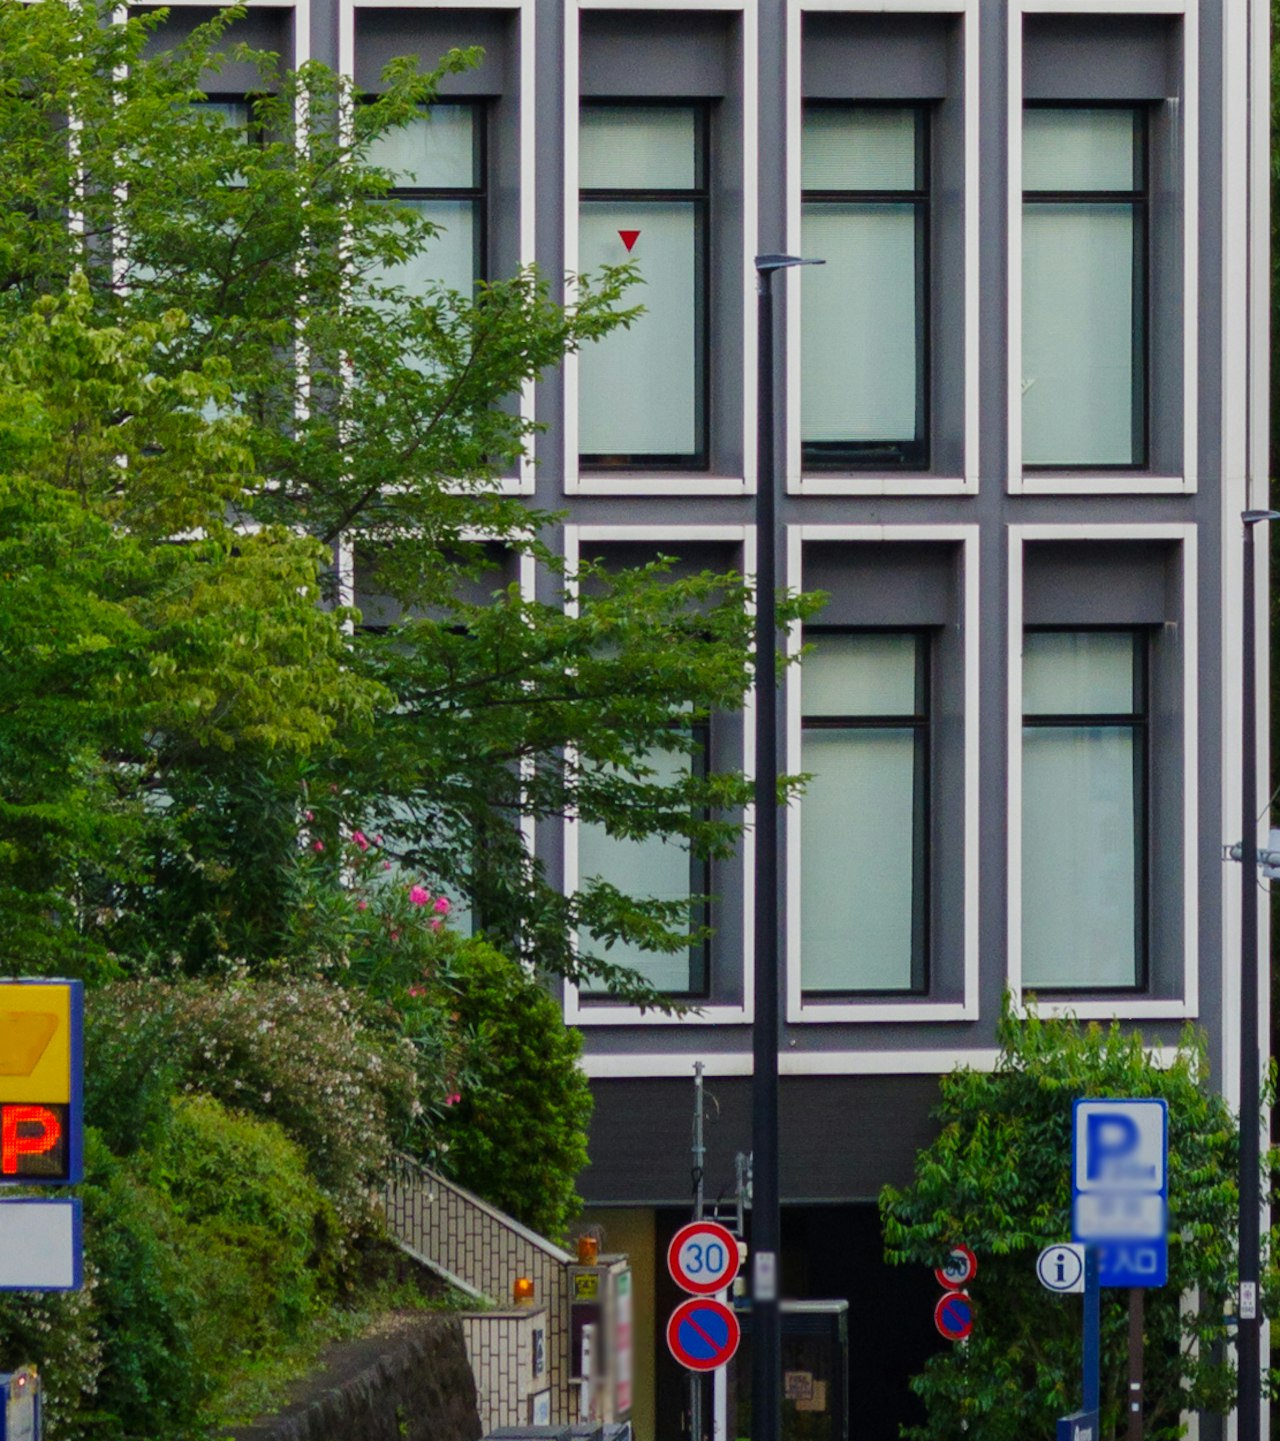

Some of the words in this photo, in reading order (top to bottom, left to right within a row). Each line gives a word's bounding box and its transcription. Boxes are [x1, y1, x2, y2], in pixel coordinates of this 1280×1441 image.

[2, 1105, 60, 1174] P
[1086, 1113, 1139, 1181] P
[686, 1243, 724, 1274] 30
